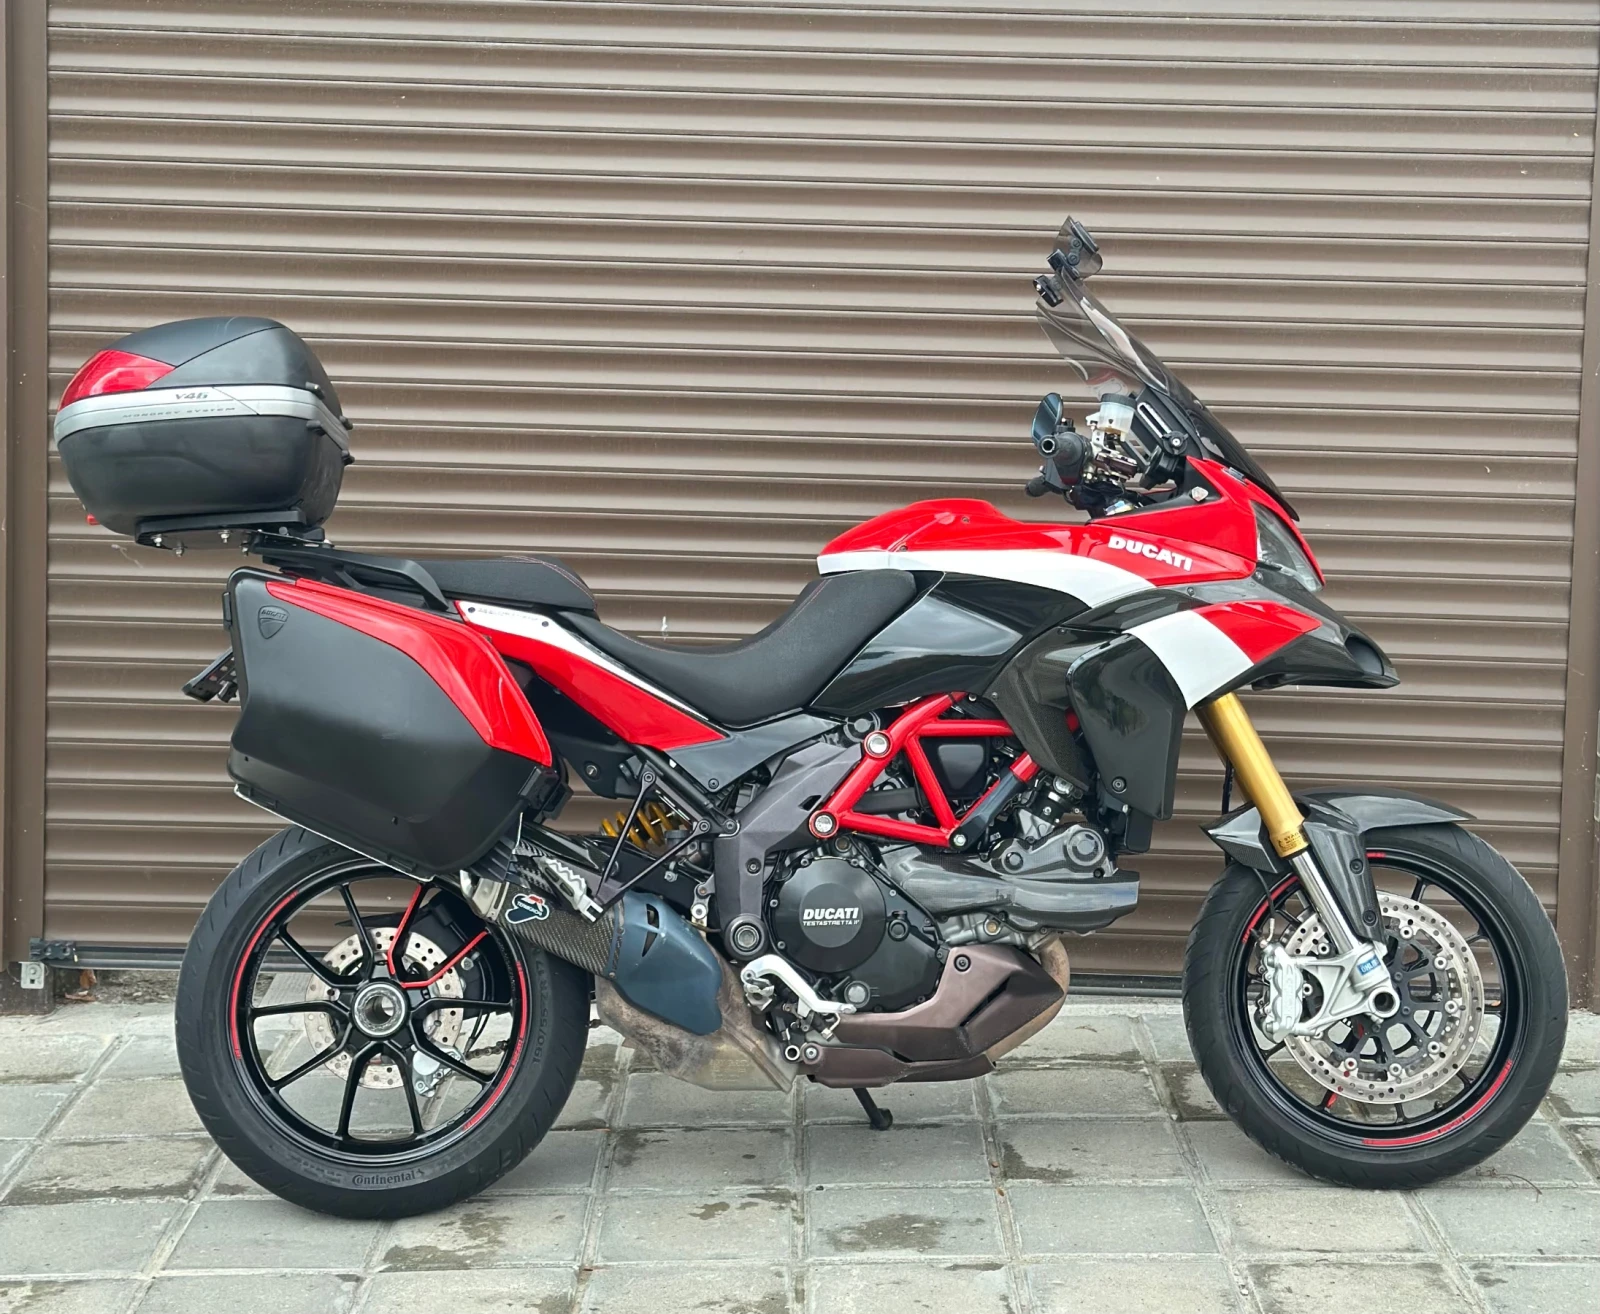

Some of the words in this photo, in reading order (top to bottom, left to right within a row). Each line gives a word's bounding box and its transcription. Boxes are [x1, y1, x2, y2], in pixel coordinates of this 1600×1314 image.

[1108, 536, 1193, 571] DUCATI
[803, 907, 859, 920] DUCATI
[352, 1170, 416, 1186] Continental
